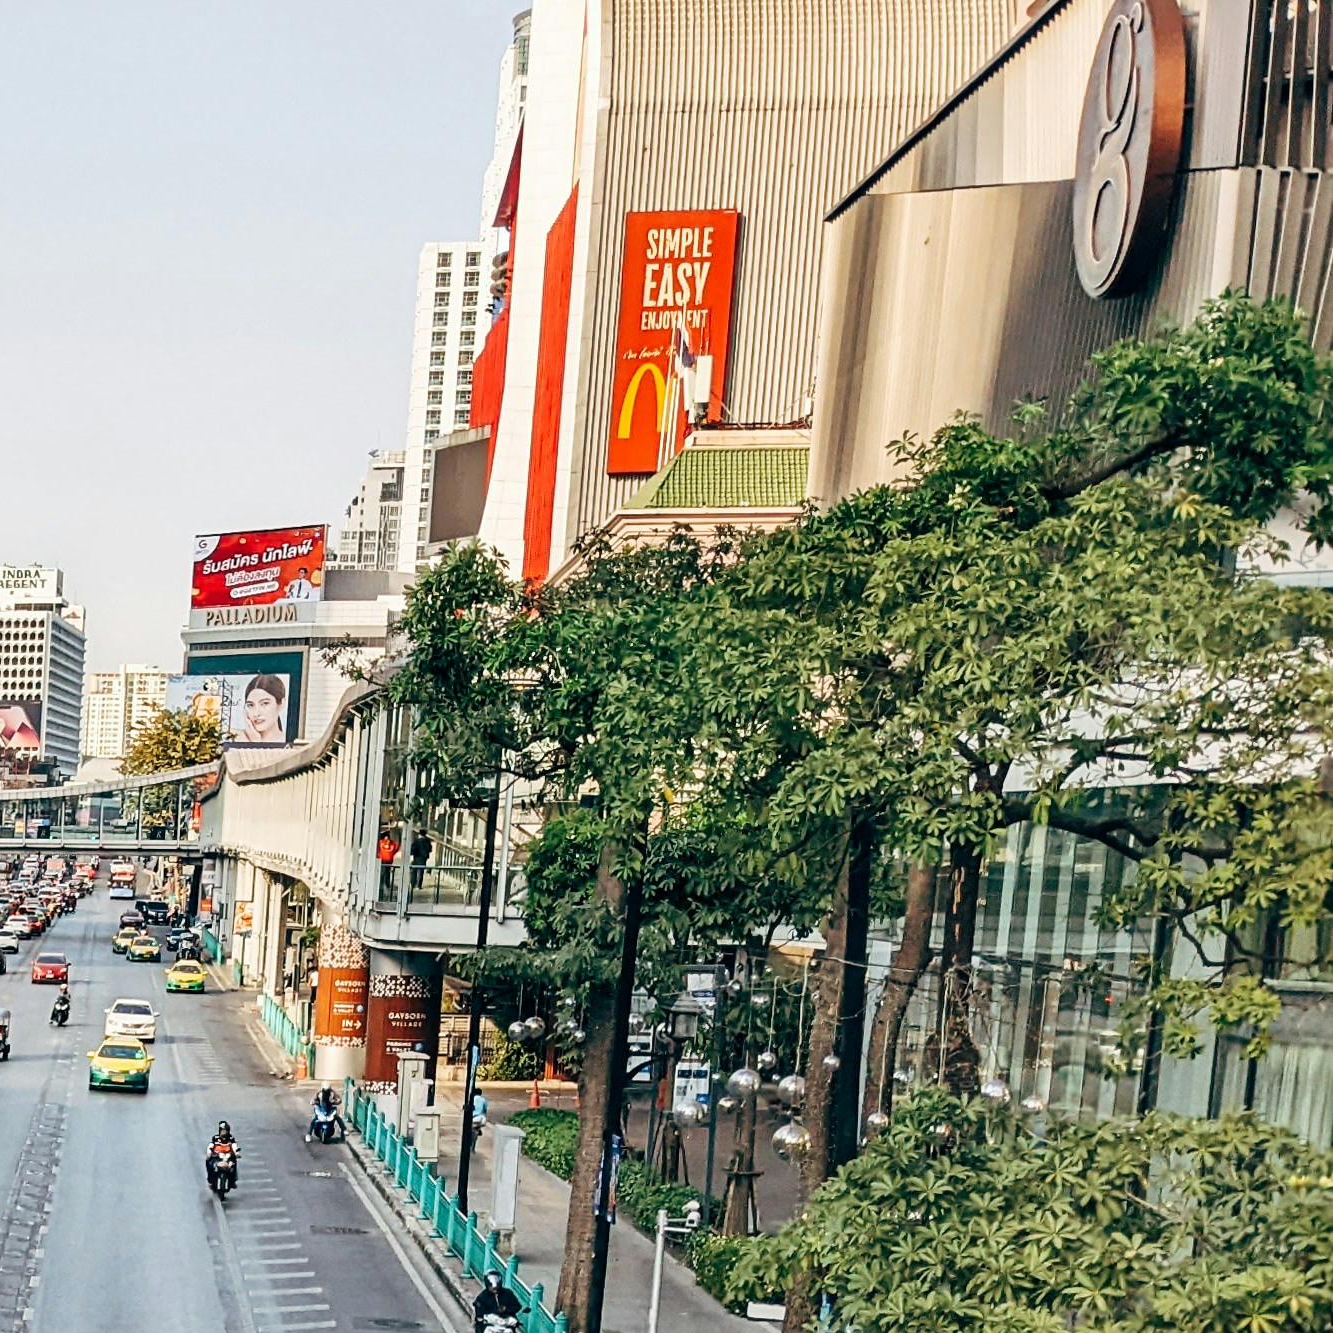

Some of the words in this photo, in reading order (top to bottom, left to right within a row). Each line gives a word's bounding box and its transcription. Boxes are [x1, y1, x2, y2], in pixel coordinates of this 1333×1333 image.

[646, 226, 714, 260] SIMPLE
[642, 261, 711, 308] EASY
[2, 569, 42, 579] INDRA
[205, 604, 298, 627] PALLADIUM
[341, 1019, 353, 1028] IN
[388, 1011, 427, 1020] GAYSORN
